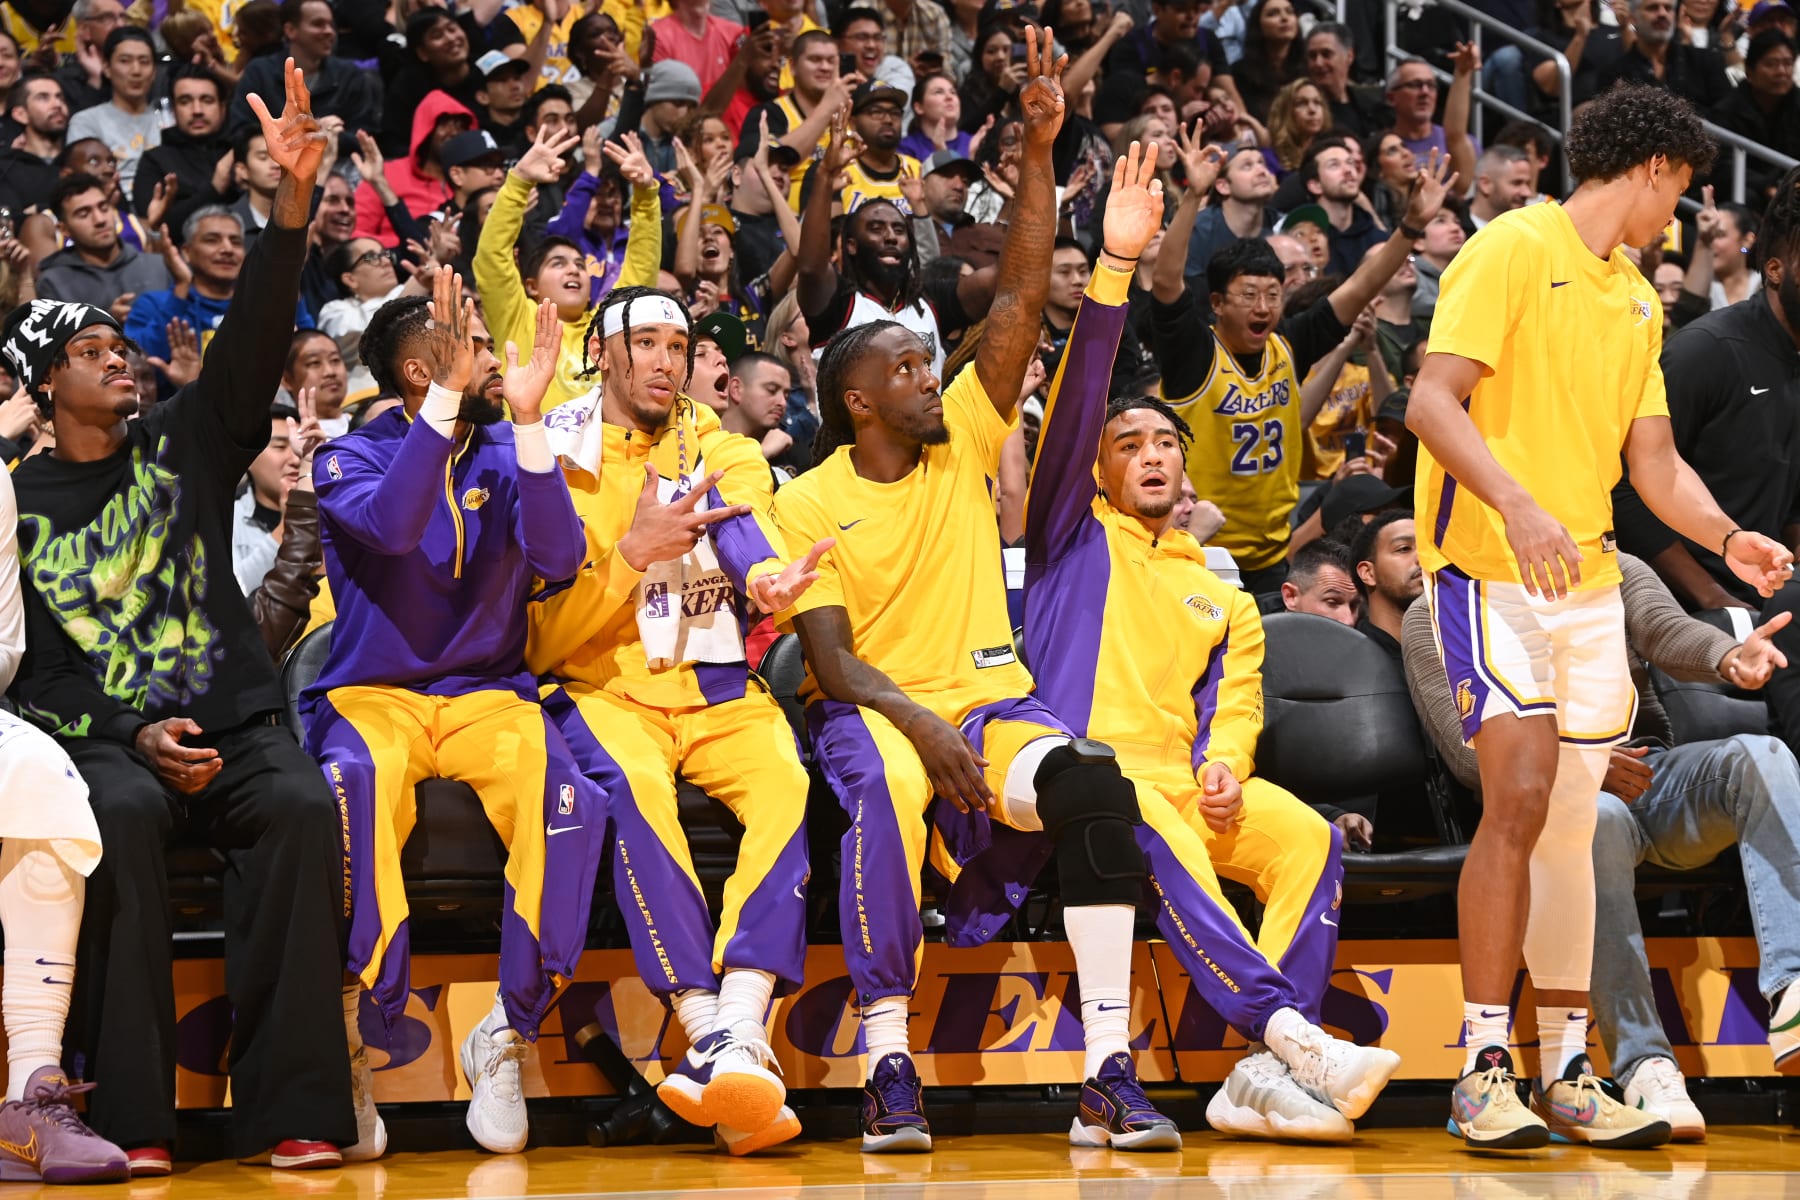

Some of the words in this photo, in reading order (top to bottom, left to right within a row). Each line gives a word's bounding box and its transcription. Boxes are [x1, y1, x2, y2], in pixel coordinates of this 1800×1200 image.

[1213, 378, 1290, 416] LAKERS
[1231, 418, 1285, 476] 23
[681, 586, 736, 617] KER
[693, 575, 731, 589] ANGE
[1186, 597, 1222, 619] LAKERS
[329, 761, 343, 782] LOS
[335, 784, 351, 852] ANGELES
[343, 855, 353, 919] LAKERS
[855, 825, 863, 890] ANGELES
[618, 840, 630, 864] LOS
[626, 867, 653, 926] ANGELES
[649, 928, 679, 984] LAKERS
[856, 894, 873, 954] LAKERS
[1162, 899, 1198, 948] ANGELES
[1197, 949, 1241, 993] LAKERS
